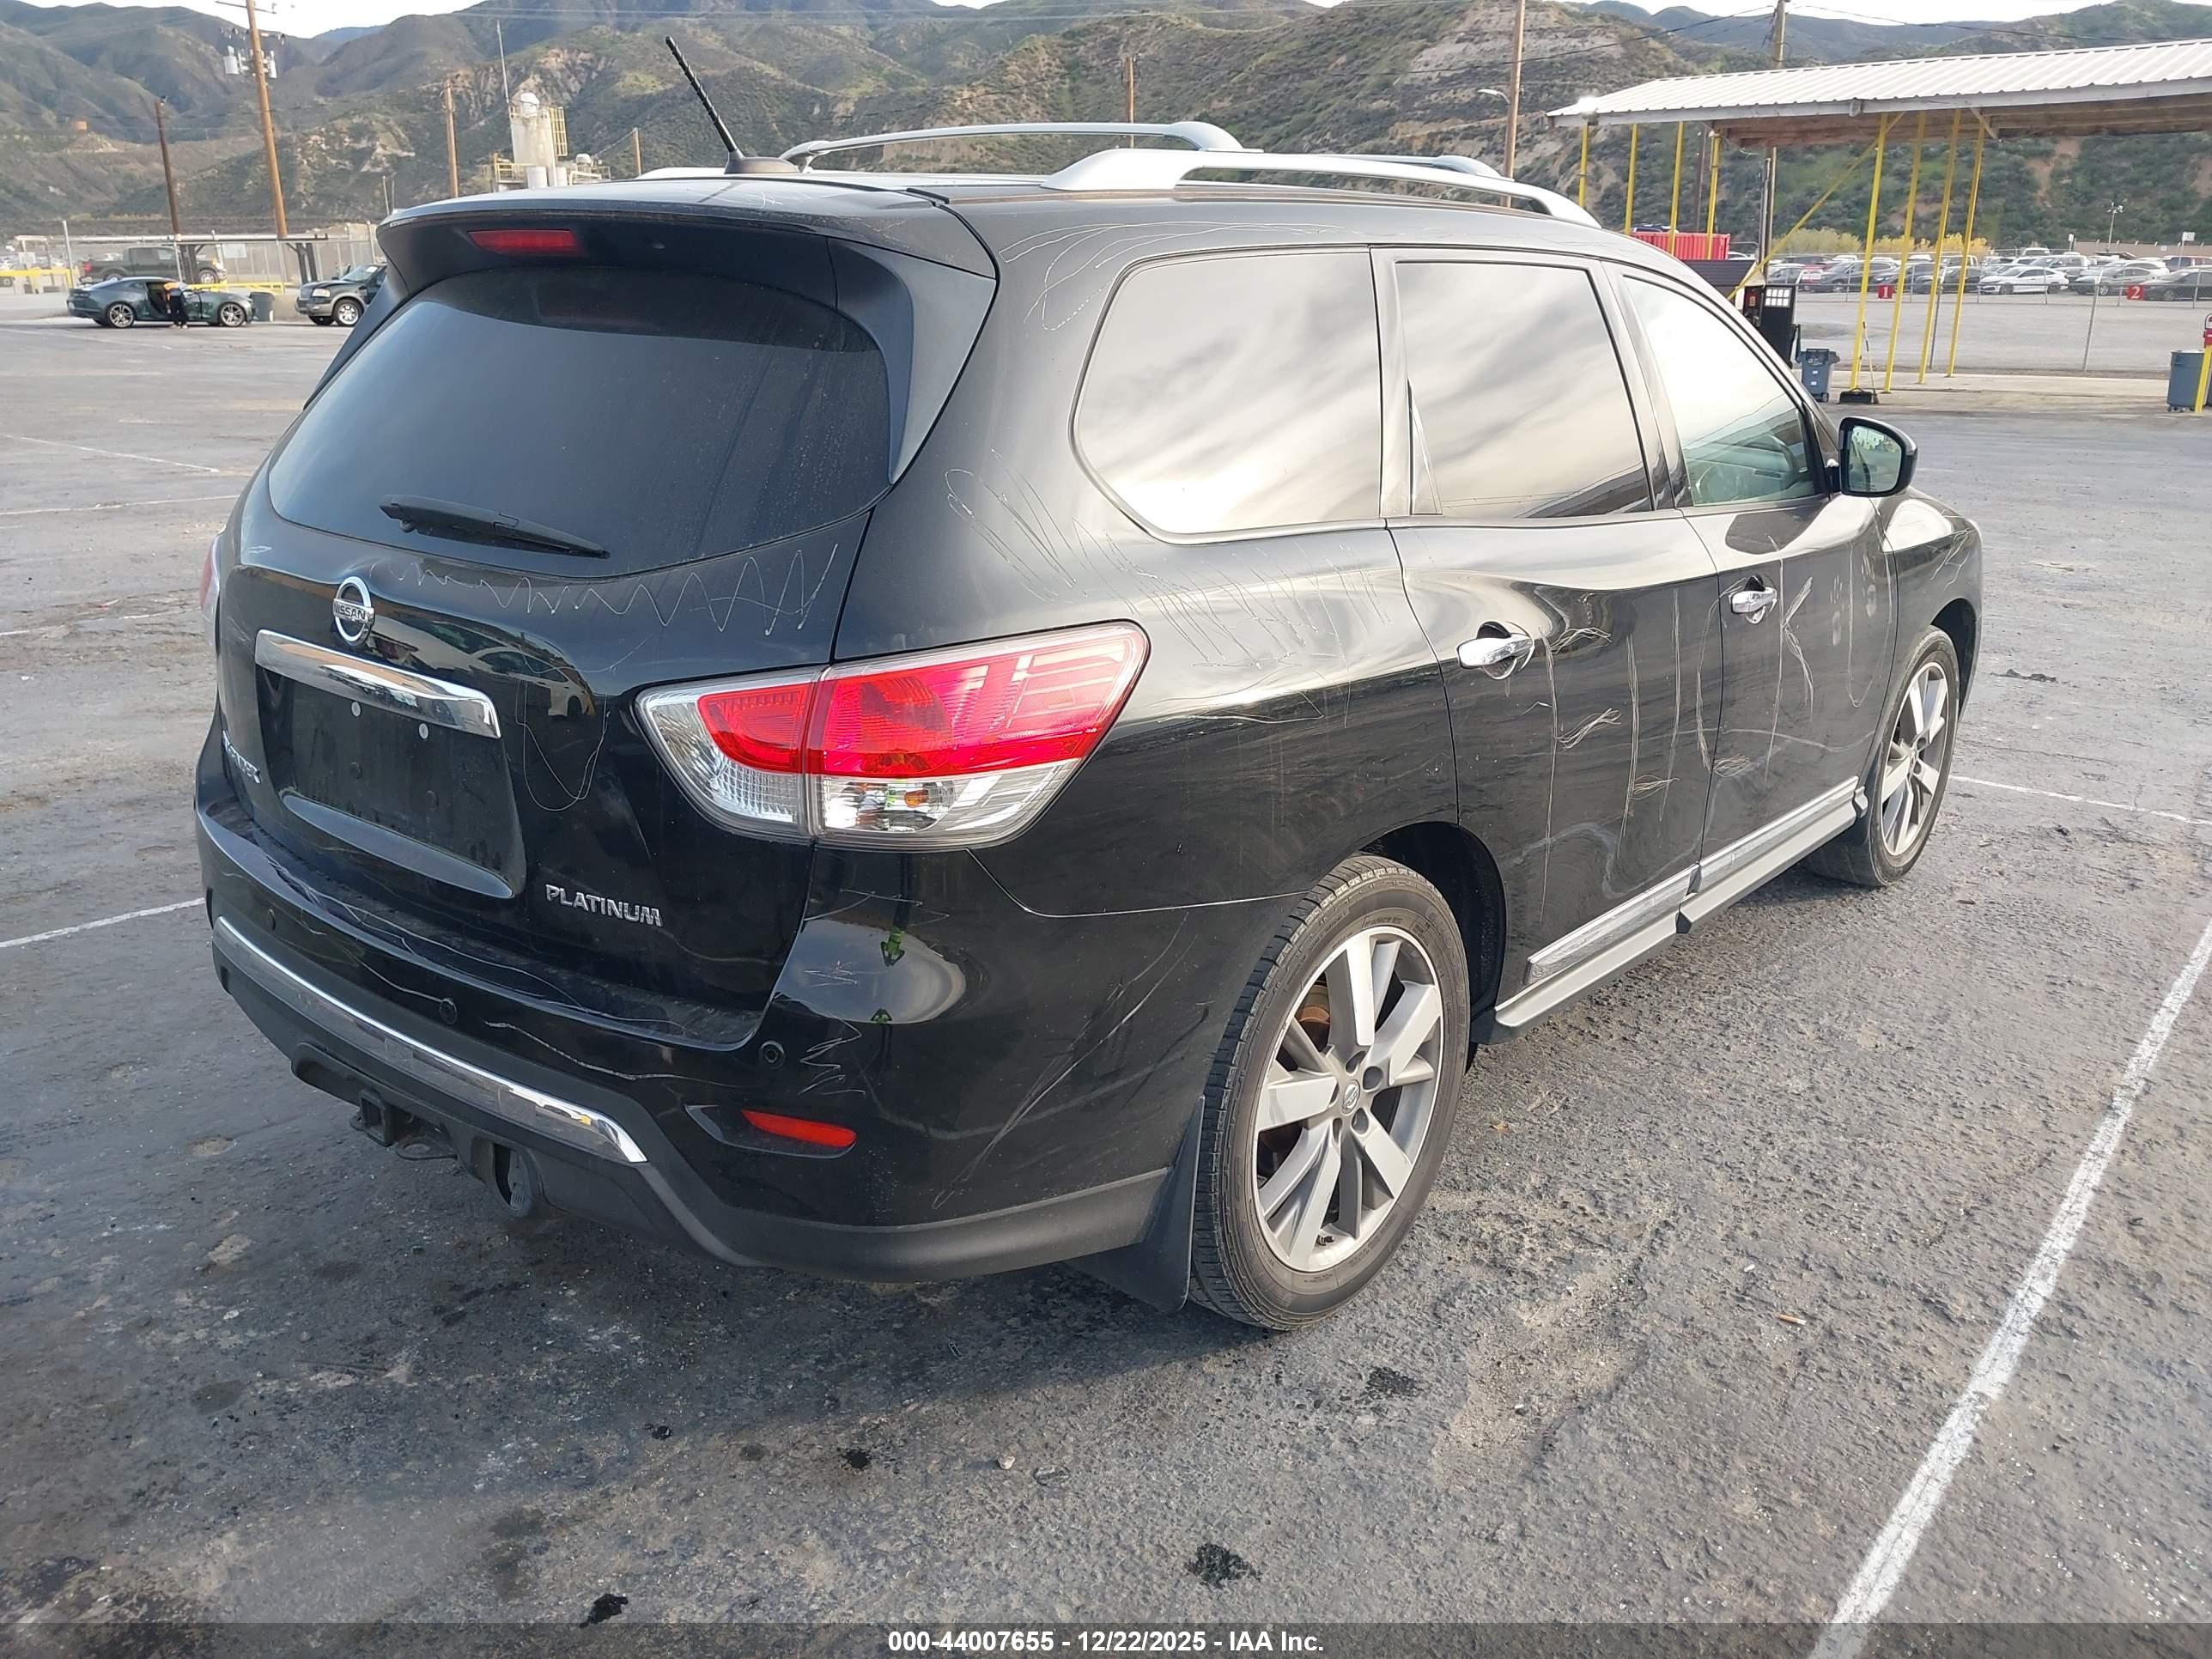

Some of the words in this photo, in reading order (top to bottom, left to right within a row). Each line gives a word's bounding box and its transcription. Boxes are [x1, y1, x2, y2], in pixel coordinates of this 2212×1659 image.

[2130, 286, 2141, 299] 2
[333, 601, 367, 620] NISSAN
[545, 884, 663, 927] PLATINUM
